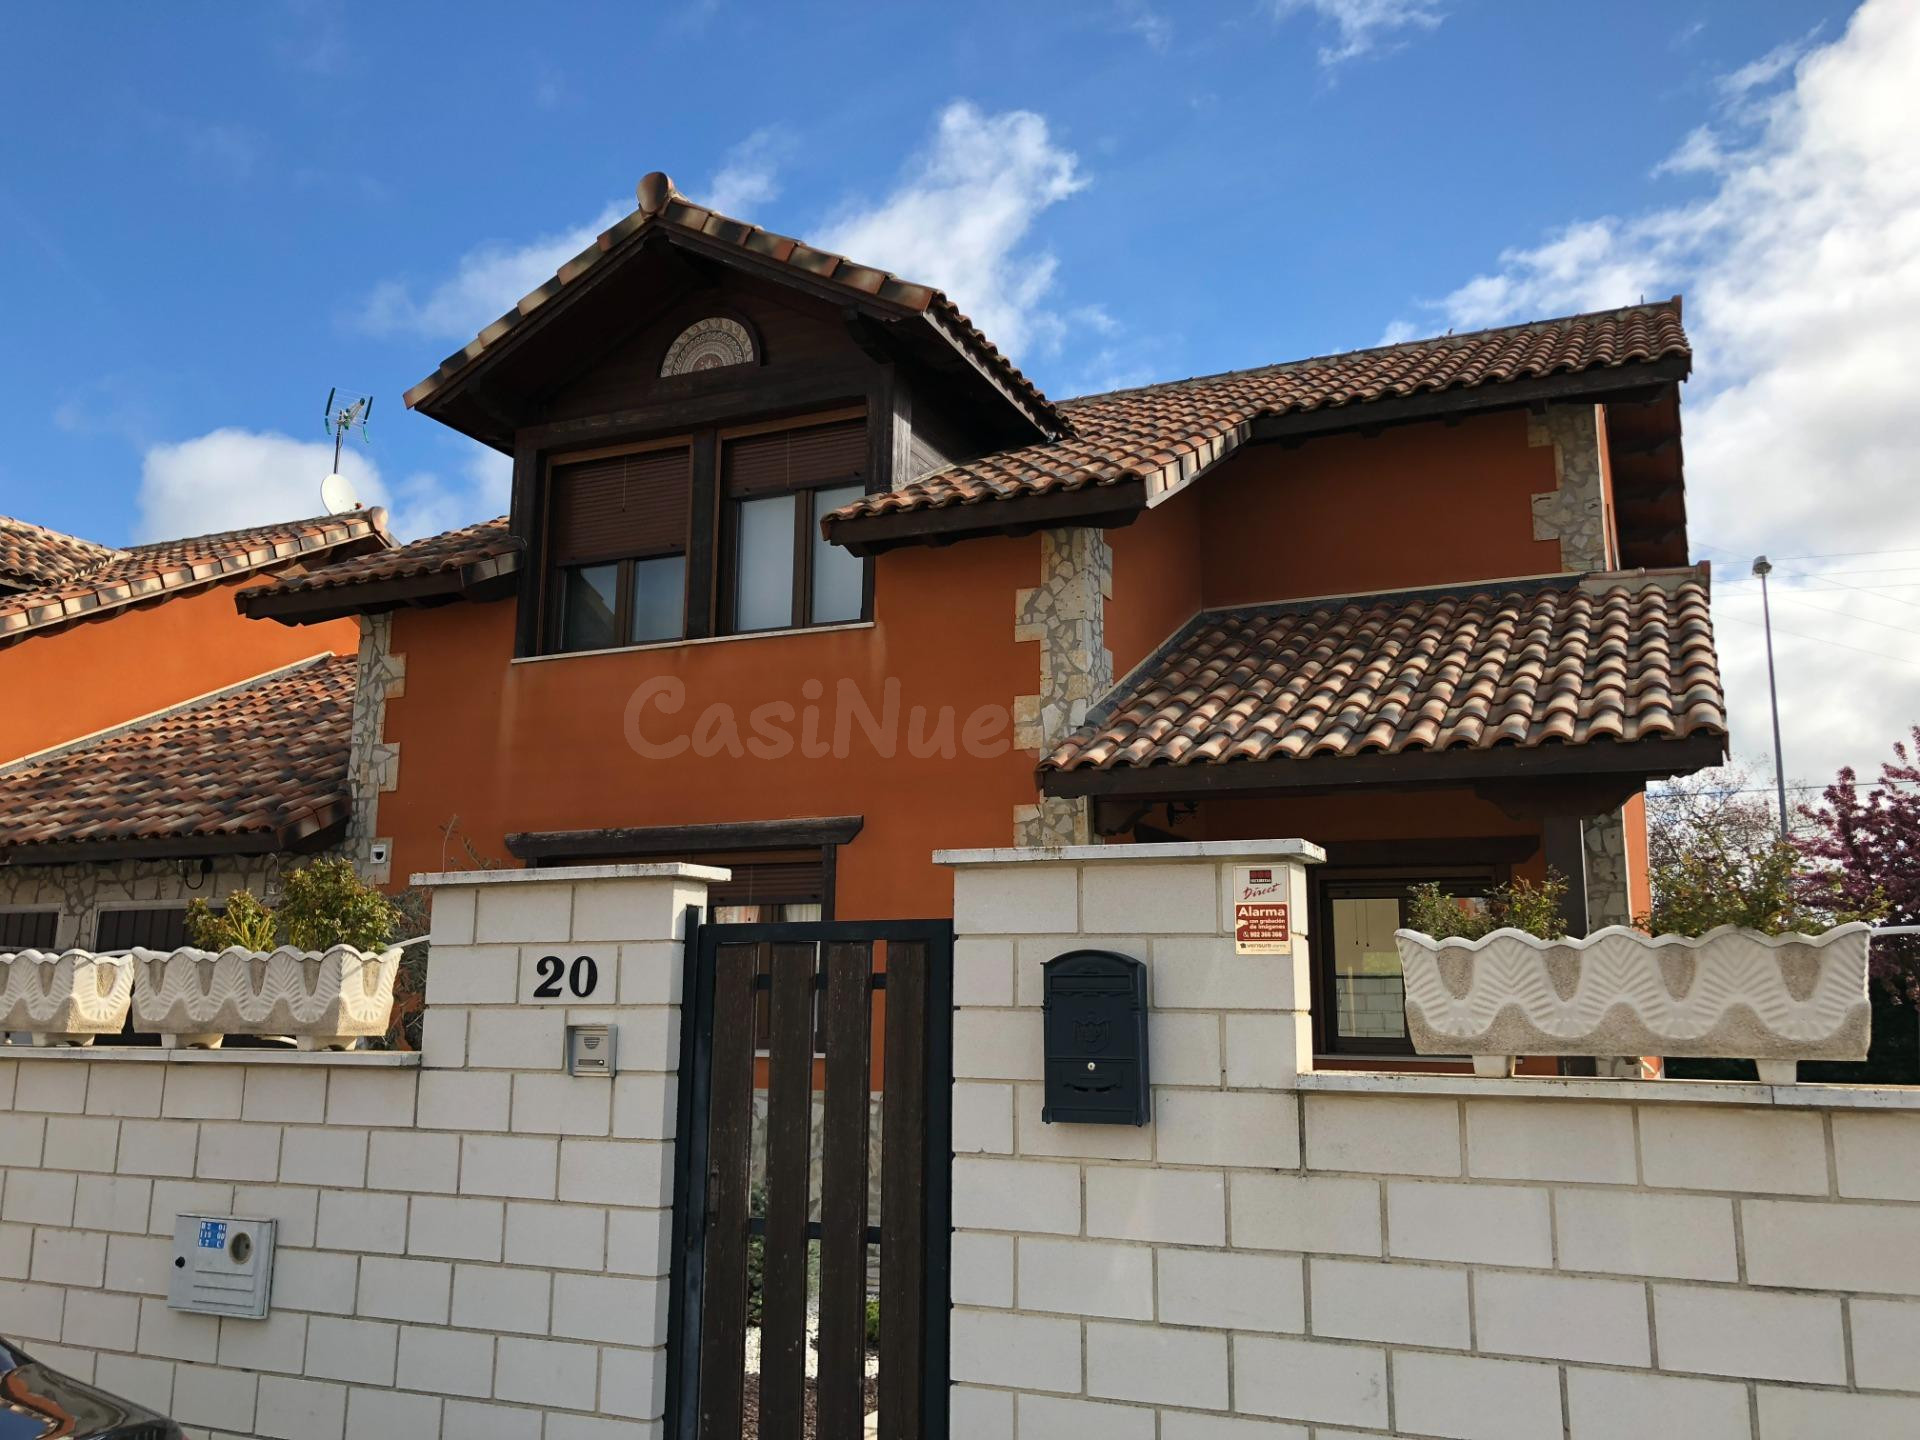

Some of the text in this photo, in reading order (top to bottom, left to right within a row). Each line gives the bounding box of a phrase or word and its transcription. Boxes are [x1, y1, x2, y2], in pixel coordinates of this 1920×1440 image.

[1243, 883, 1281, 900] Direct
[1238, 906, 1285, 917] Alarma
[533, 955, 598, 998] 20
